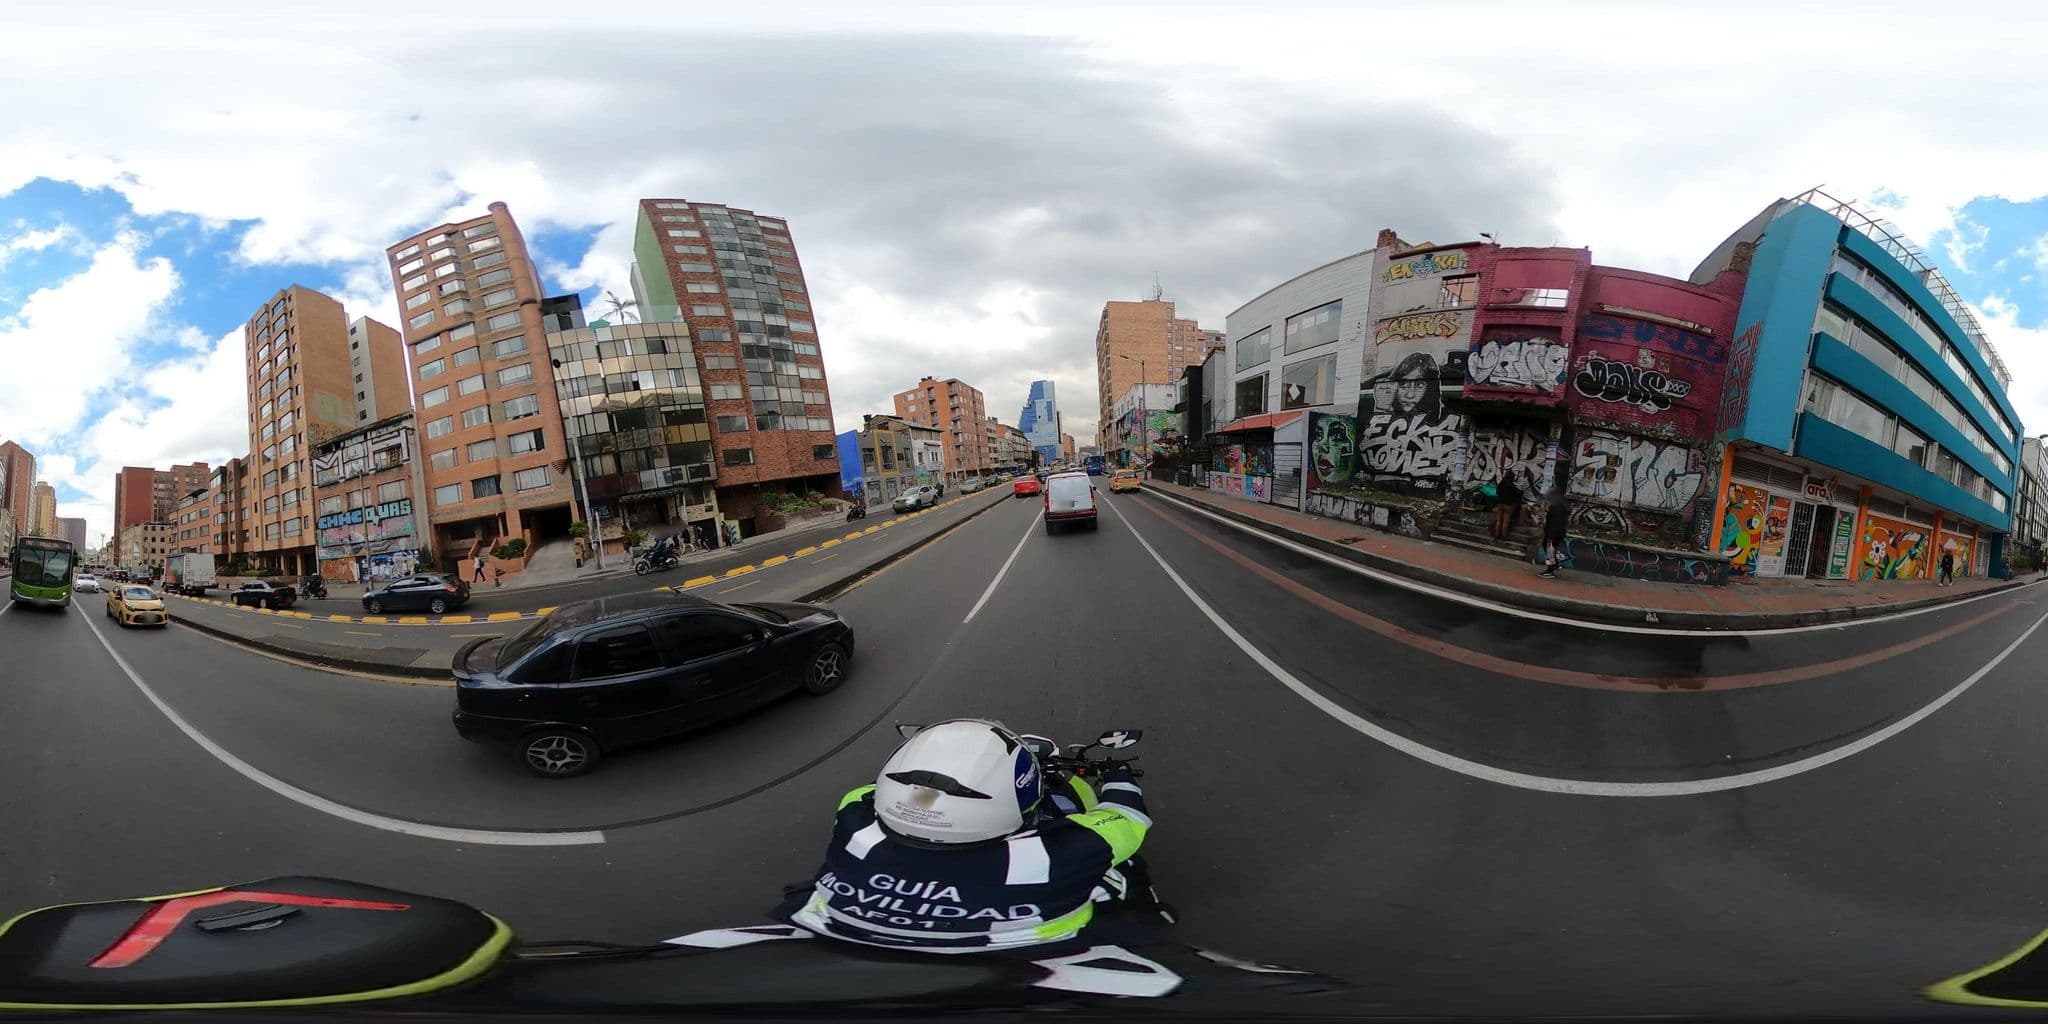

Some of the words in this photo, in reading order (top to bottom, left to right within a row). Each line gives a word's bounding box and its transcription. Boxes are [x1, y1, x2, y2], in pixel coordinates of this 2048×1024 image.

[1807, 485, 1826, 499] ara
[820, 871, 1041, 920] MOVILIDAD
[868, 873, 961, 902] GUÍA
